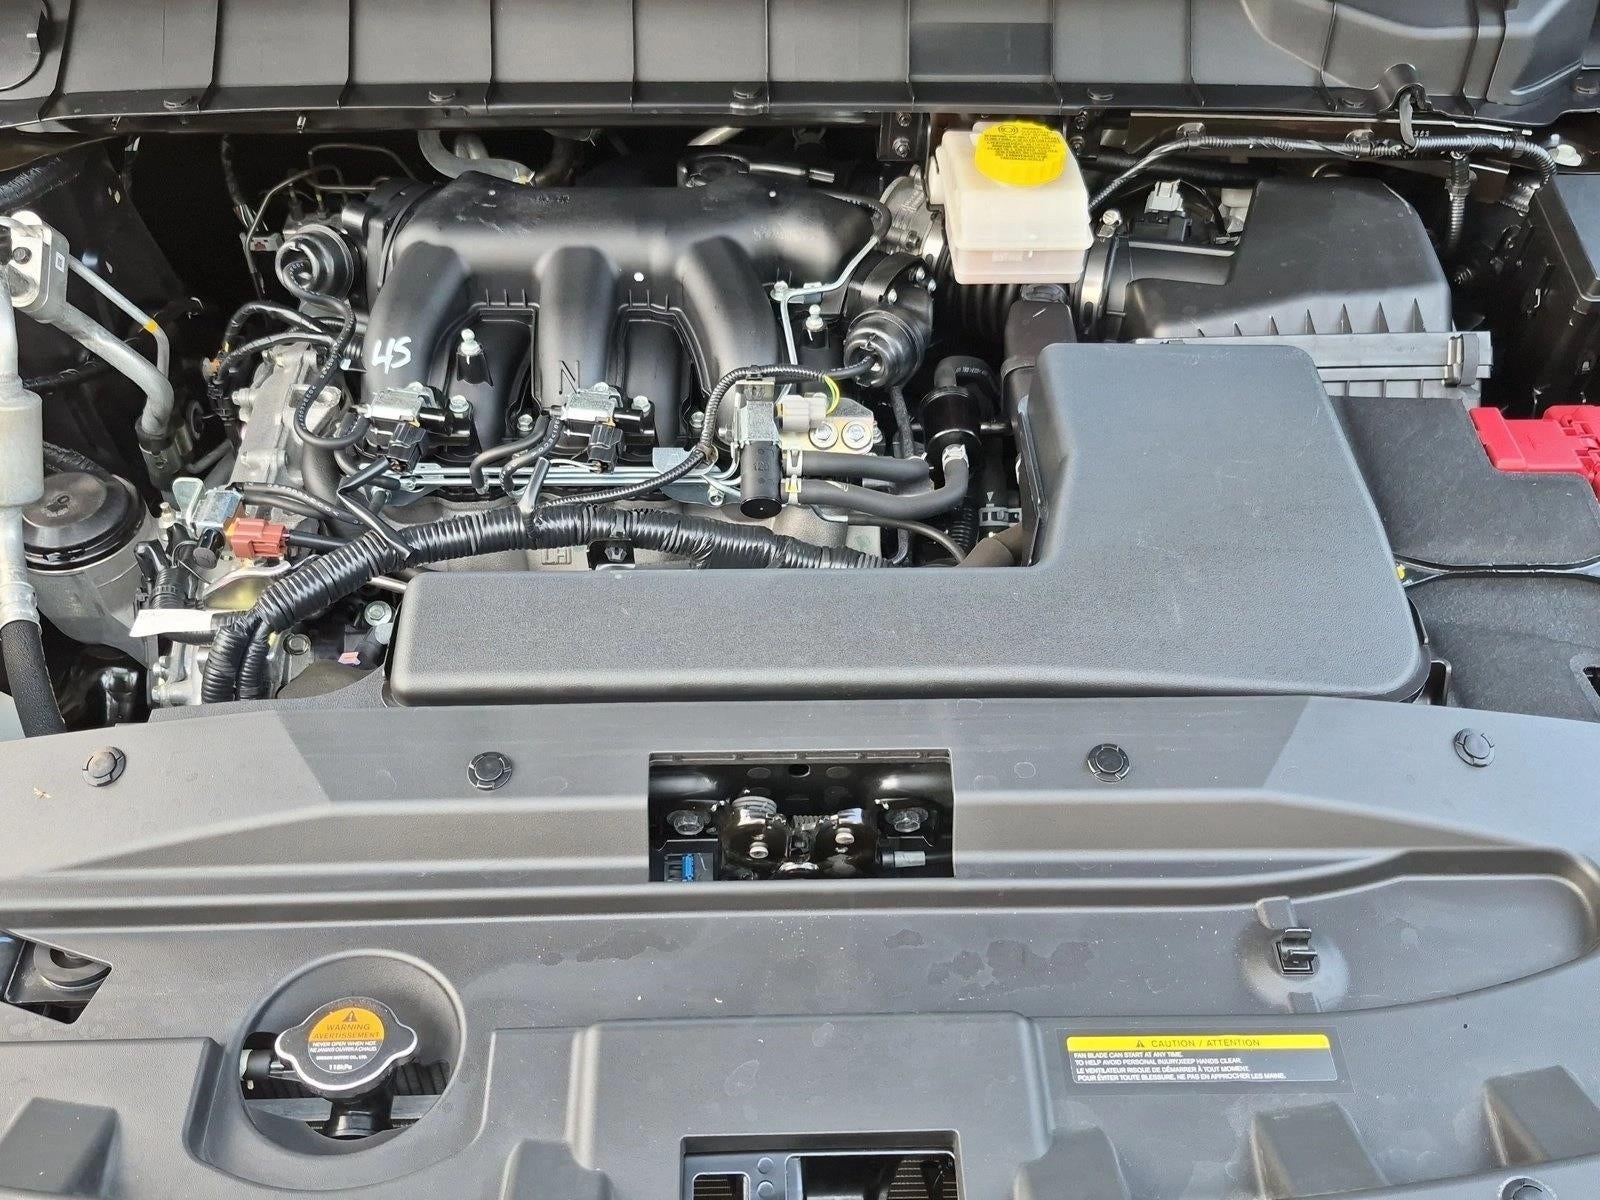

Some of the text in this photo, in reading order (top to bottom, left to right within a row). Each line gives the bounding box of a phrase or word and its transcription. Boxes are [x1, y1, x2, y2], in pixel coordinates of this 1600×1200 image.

[326, 1023, 370, 1031] WARNING
[313, 1031, 379, 1039] AVERTISSEMENT
[1151, 1040, 1196, 1048] CAUTION
[1206, 1038, 1260, 1047] ATTENTION
[1085, 1066, 1127, 1074] VENTILATEUR
[1126, 1066, 1151, 1074] RISQUE
[1096, 1072, 1120, 1081] ÉVITER
